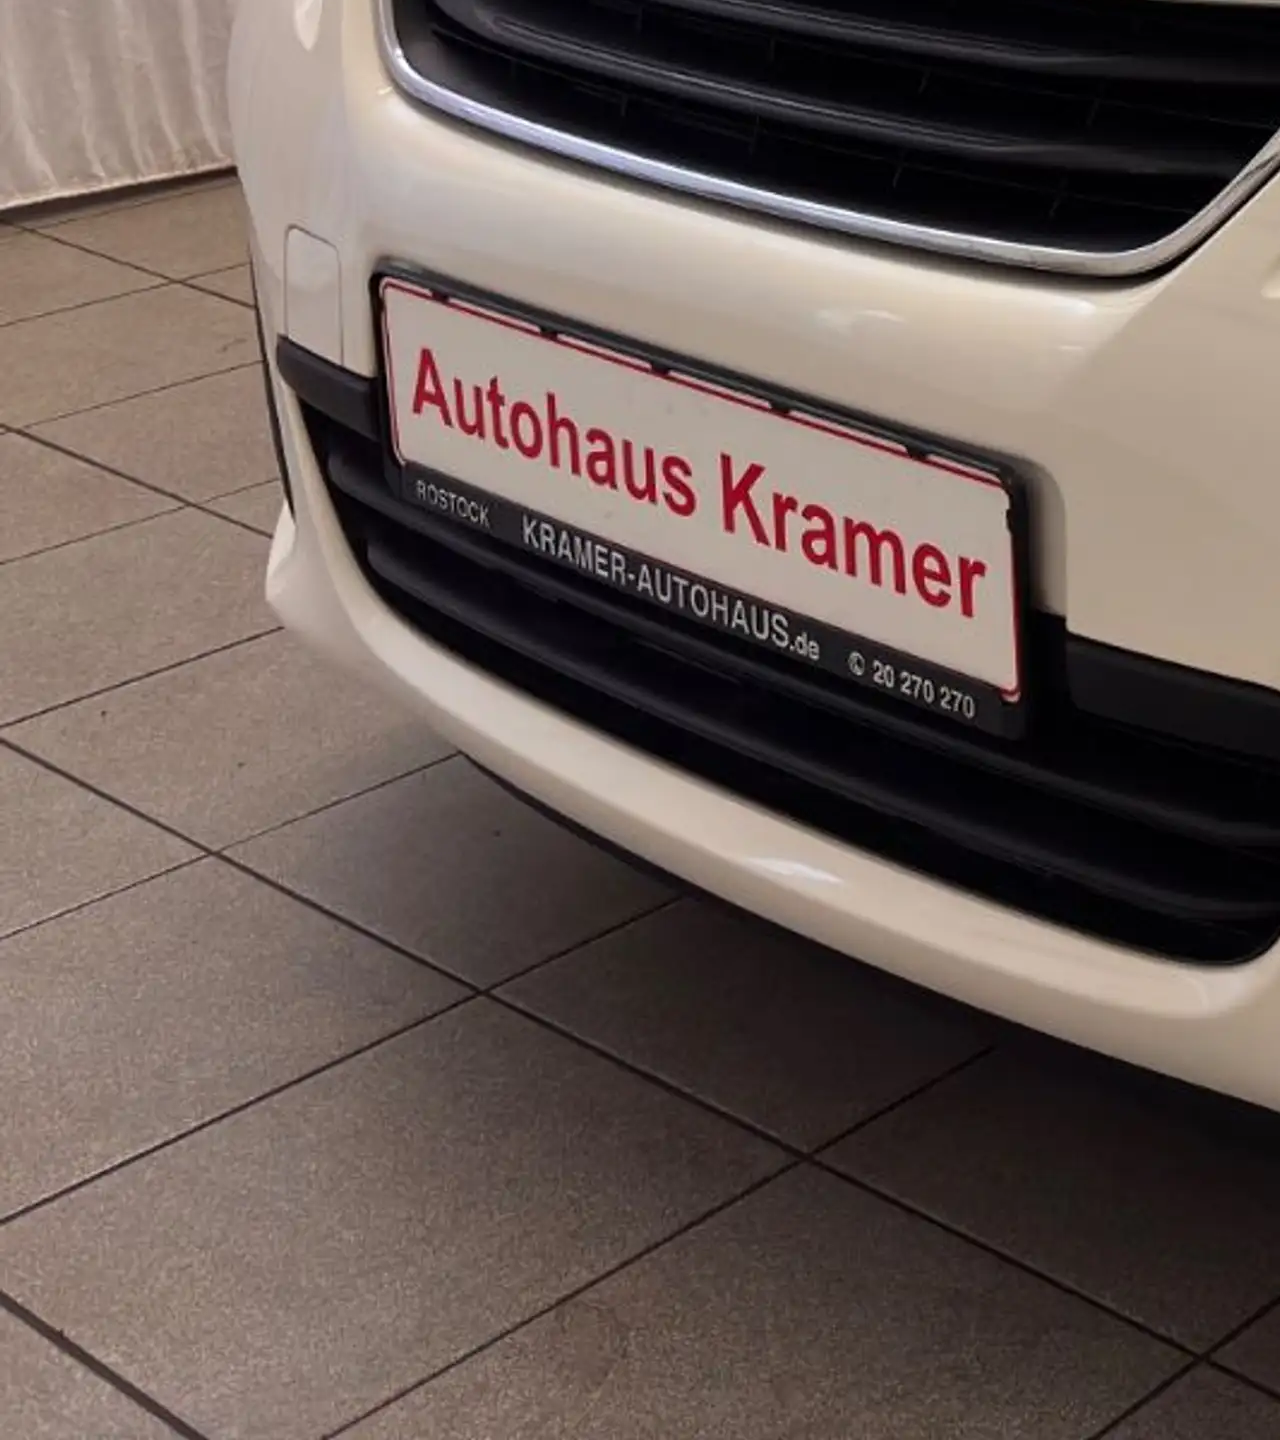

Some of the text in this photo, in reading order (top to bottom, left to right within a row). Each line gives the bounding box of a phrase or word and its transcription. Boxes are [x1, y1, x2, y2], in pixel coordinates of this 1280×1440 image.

[412, 347, 988, 618] Autohaus Kramer
[415, 479, 977, 720] ROSTOCK KRAMER-AUTOHAUS.de 20 270 270
